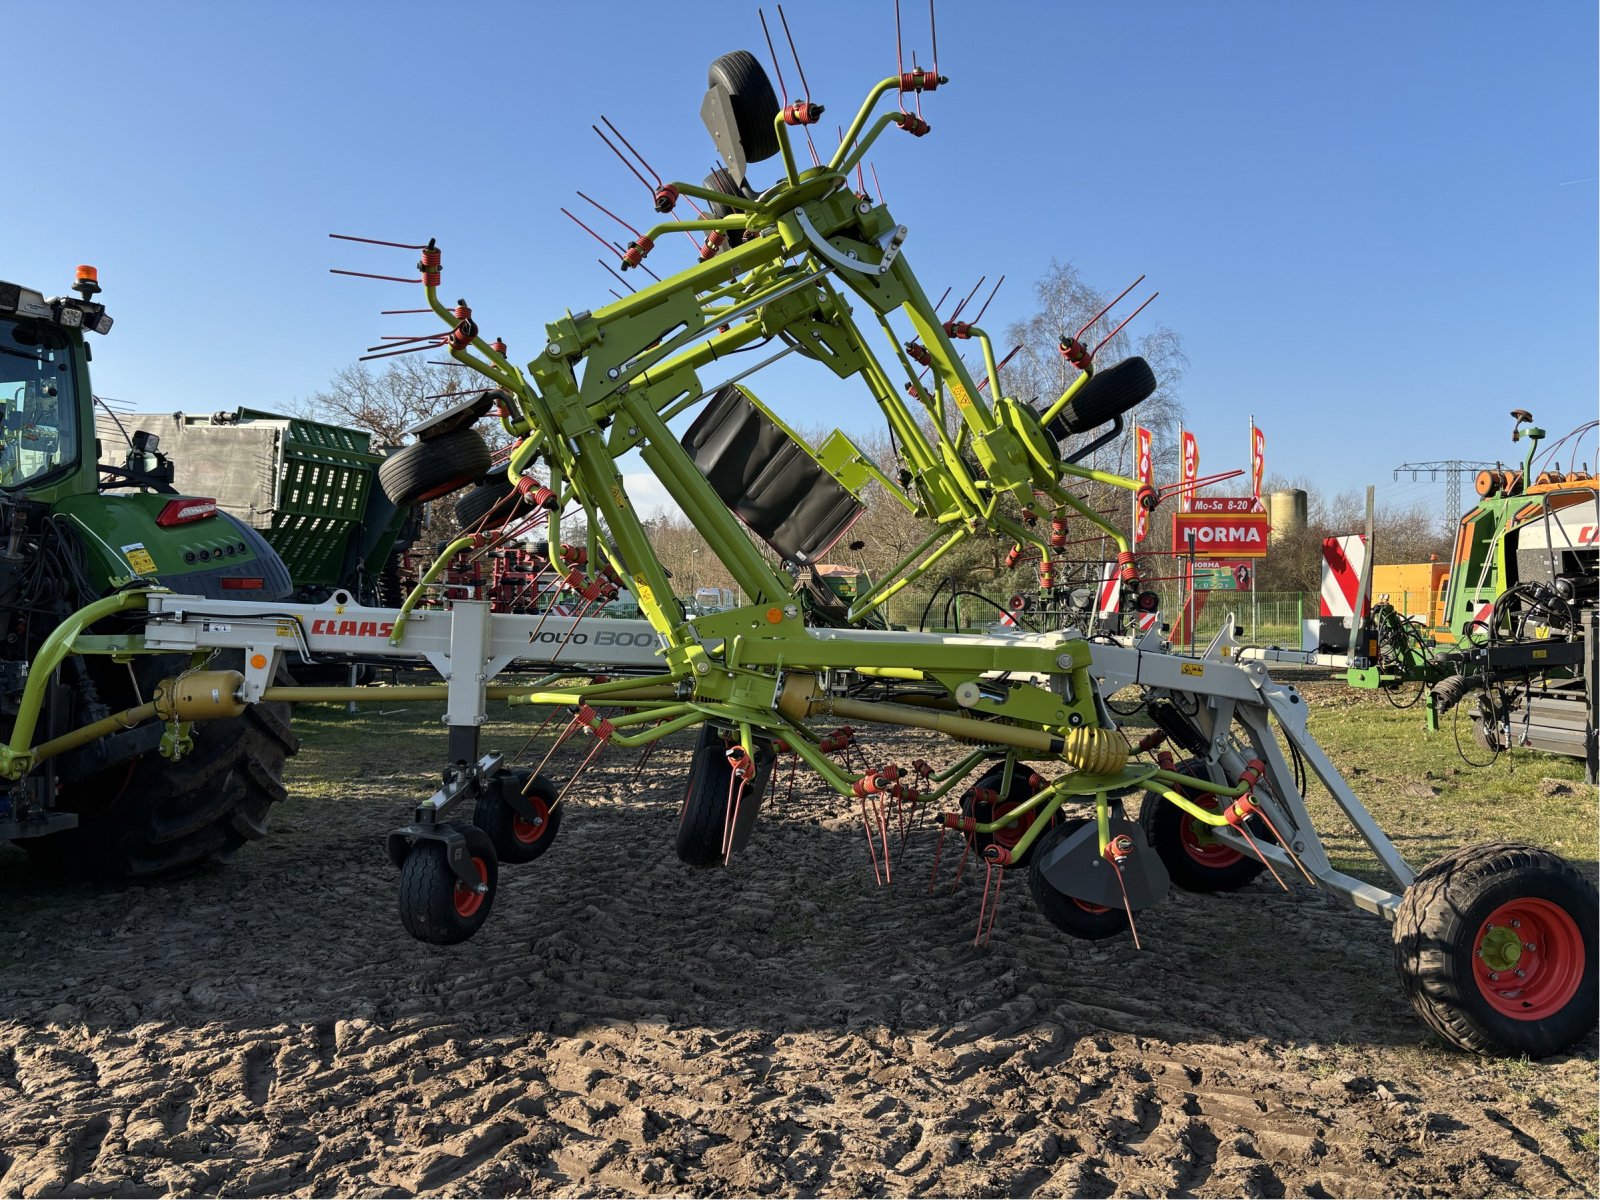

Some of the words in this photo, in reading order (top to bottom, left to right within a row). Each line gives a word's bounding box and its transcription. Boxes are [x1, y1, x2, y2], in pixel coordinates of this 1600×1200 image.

[1194, 501, 1223, 510] Mo-Sa
[1227, 501, 1248, 510] 8-20
[1183, 527, 1261, 542] NORMA
[311, 619, 396, 637] CLAAS
[528, 631, 588, 645] VOLTO
